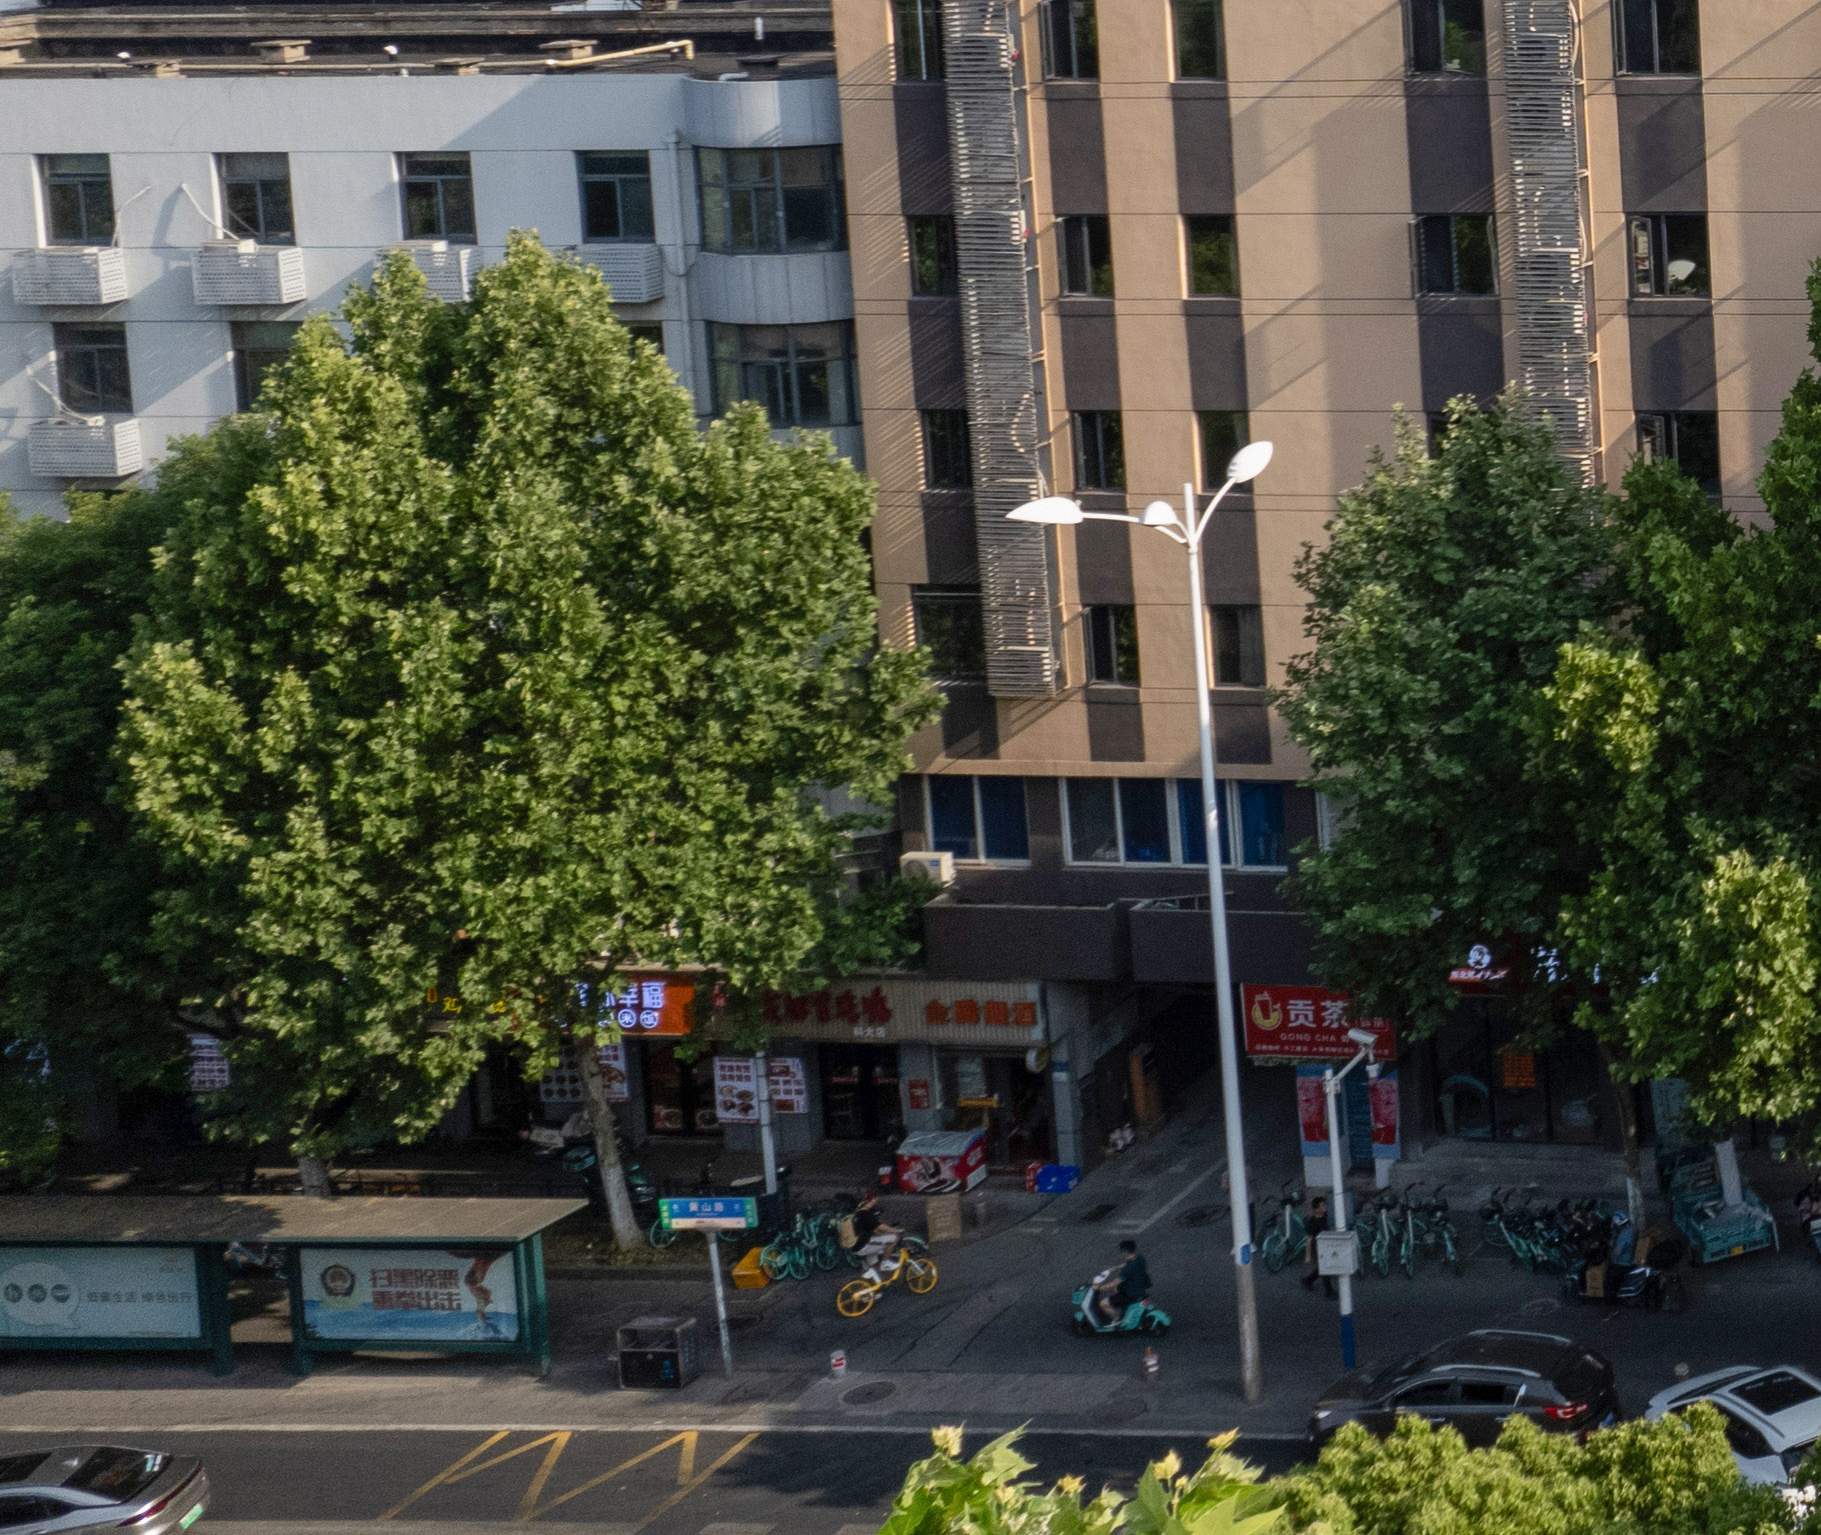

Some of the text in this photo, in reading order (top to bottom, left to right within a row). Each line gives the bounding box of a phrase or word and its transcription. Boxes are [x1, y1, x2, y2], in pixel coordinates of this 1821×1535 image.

[1287, 999, 1350, 1029] 贡茶
[369, 1268, 460, 1290] 扫黑除恶
[372, 1290, 462, 1311] 重拳出击
